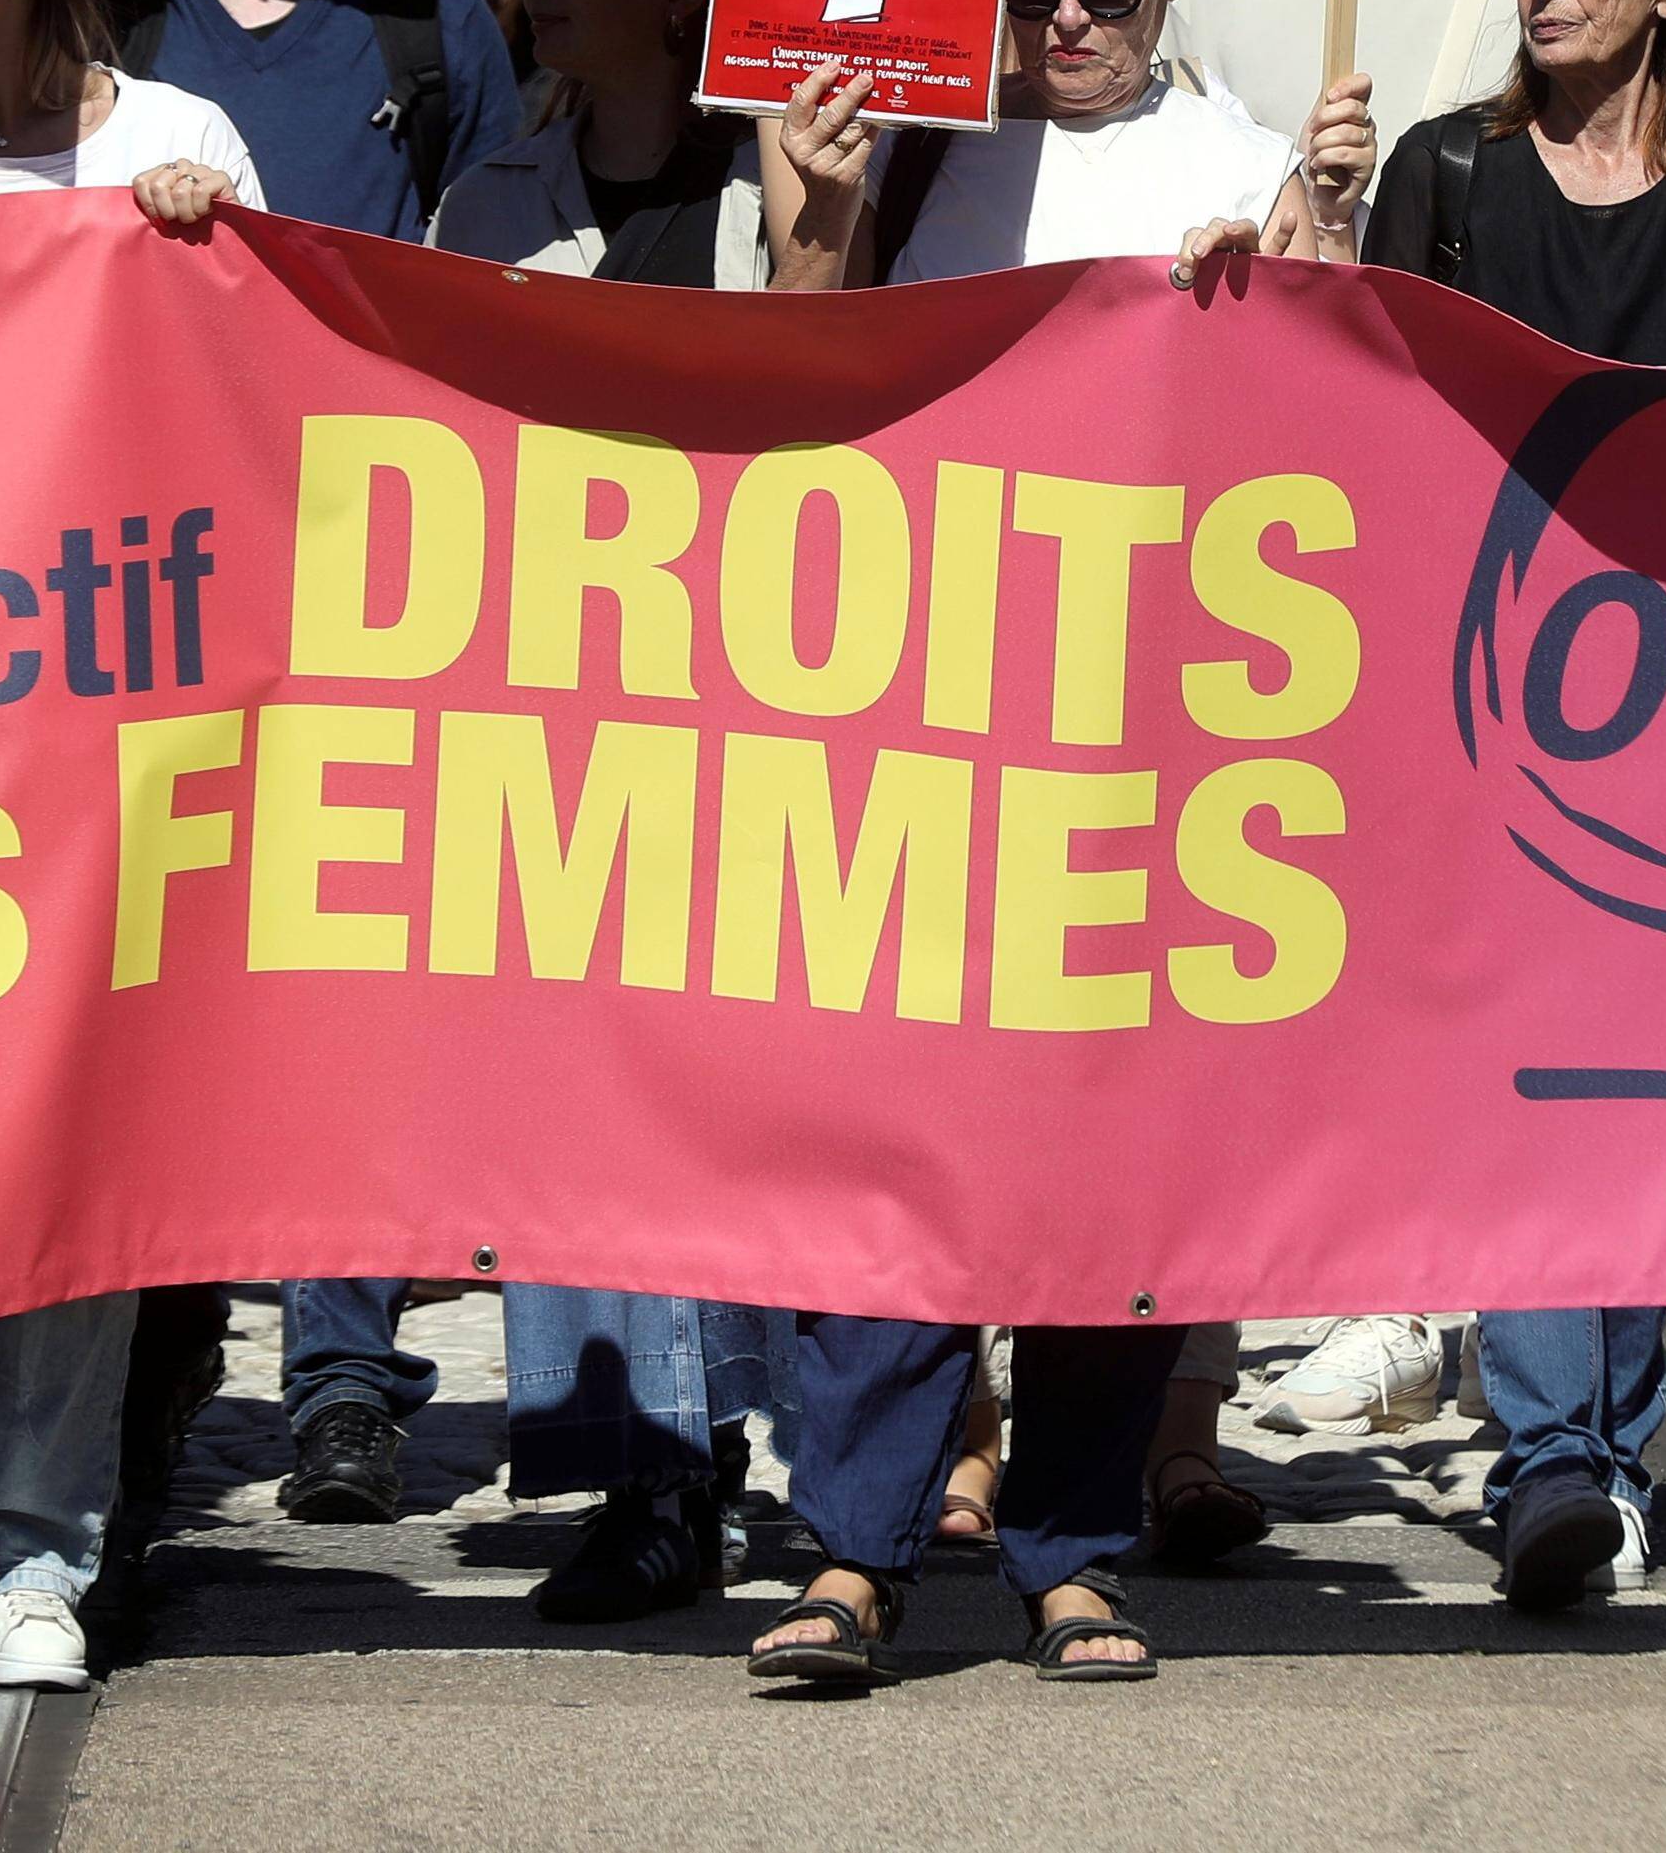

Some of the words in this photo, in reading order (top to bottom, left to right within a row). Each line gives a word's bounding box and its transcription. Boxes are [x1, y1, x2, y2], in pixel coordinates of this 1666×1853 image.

[904, 35, 912, 45] 2
[723, 55, 770, 67] AGISSONS
[773, 60, 799, 70] POUR
[876, 69, 913, 82] FEMMES
[913, 73, 921, 83] Y
[921, 75, 945, 85] AIENT
[772, 46, 849, 64] L'AVORTEMENT
[853, 56, 872, 66] EST
[875, 57, 892, 67] UN
[895, 59, 930, 72] DROIT.
[288, 414, 1361, 746] DROITS
[108, 703, 1349, 1032] FEMMES
